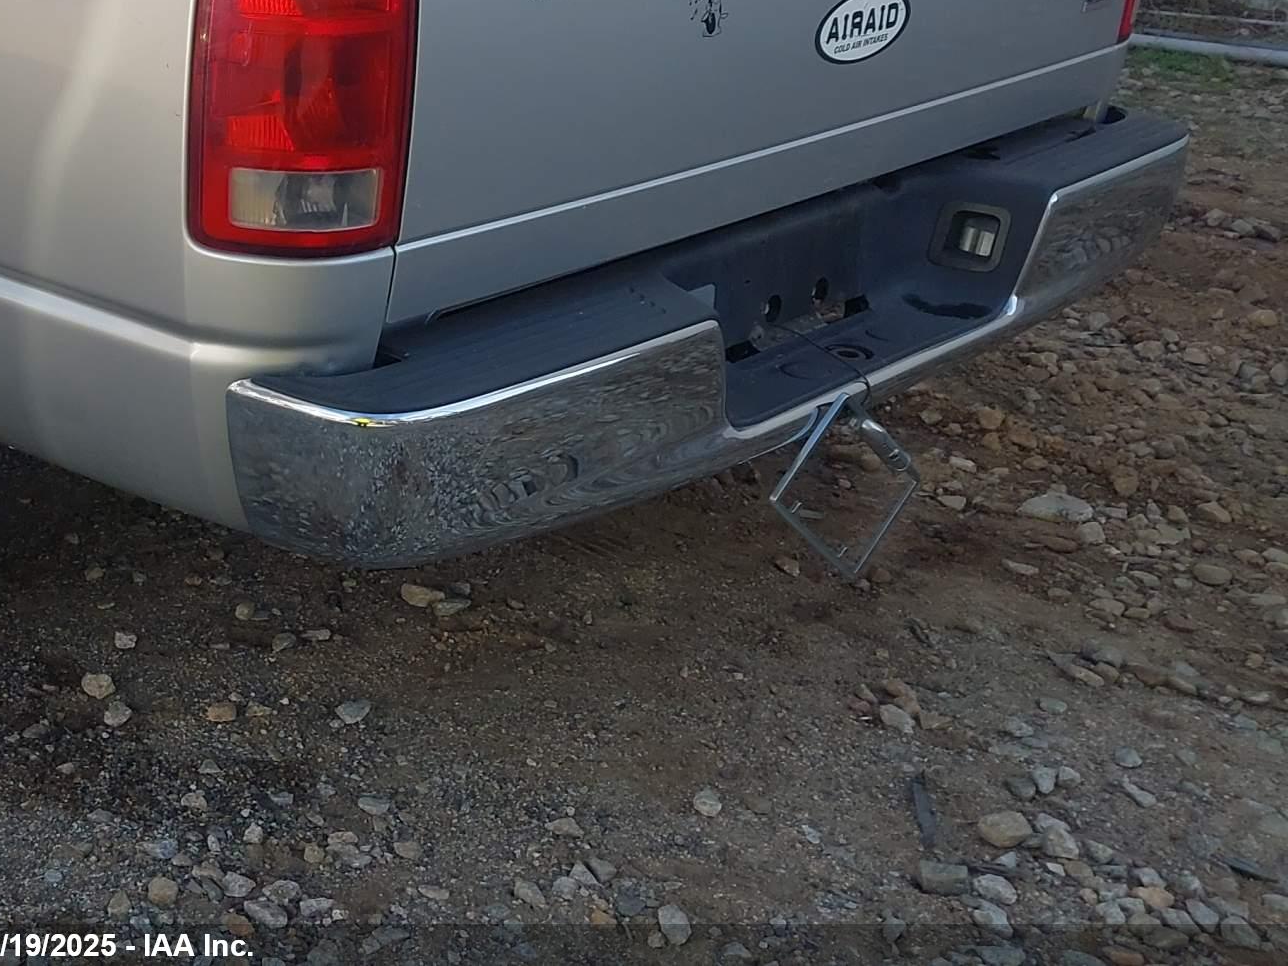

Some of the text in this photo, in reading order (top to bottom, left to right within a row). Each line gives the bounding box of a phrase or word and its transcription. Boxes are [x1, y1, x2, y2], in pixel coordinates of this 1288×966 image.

[825, 1, 900, 45] AIRAID
[833, 33, 890, 55] COLD AIR INTAKES
